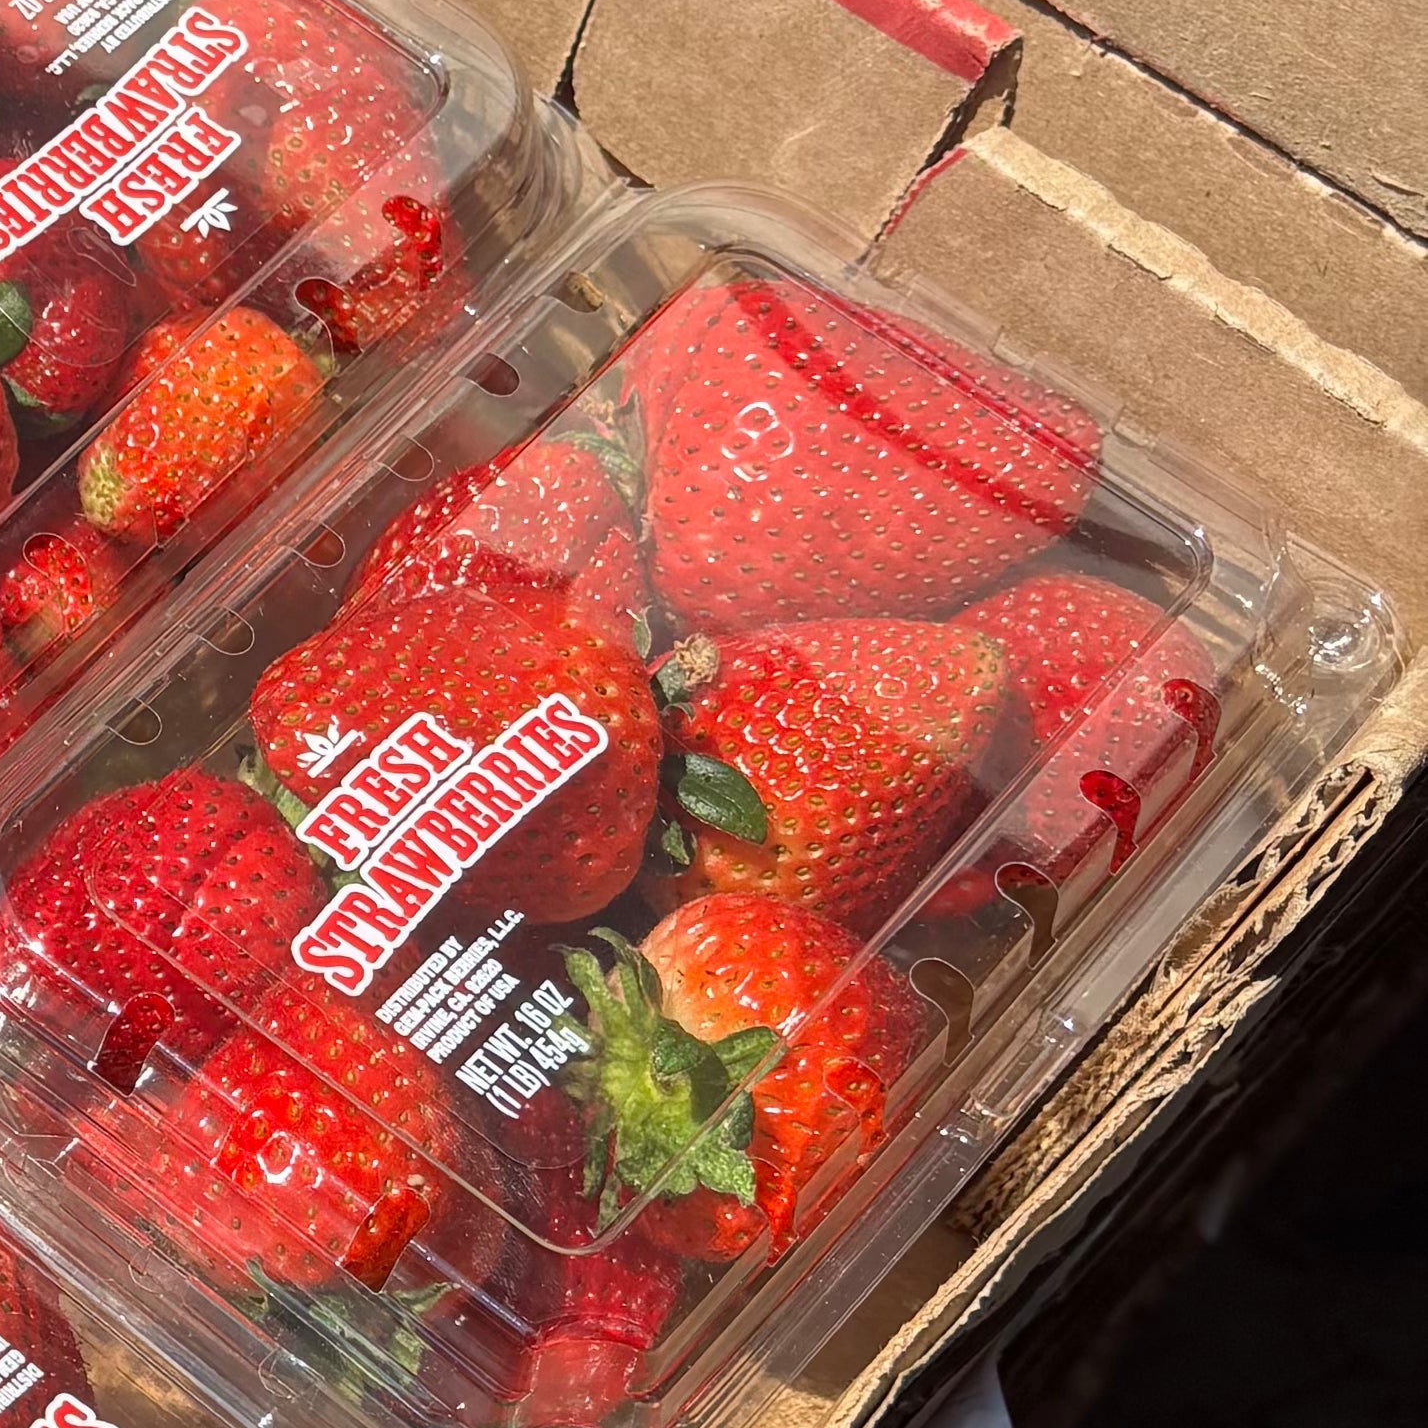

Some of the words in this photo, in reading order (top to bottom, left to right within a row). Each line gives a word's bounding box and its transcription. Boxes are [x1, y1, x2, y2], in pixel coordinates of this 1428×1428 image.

[86, 110, 237, 241] FRESH
[301, 714, 464, 866] FRESH
[298, 699, 602, 993] STRAWBERRIES
[437, 935, 464, 960] BY
[424, 1007, 485, 1065] PRODUCT
[472, 993, 499, 1017] OF
[486, 970, 521, 1002] USA
[511, 998, 554, 1037] 16
[530, 975, 576, 1018] OZ
[481, 1018, 534, 1068] WT.
[526, 1017, 592, 1079] 454g
[453, 1047, 506, 1096] NET
[500, 1055, 553, 1103] LB)
